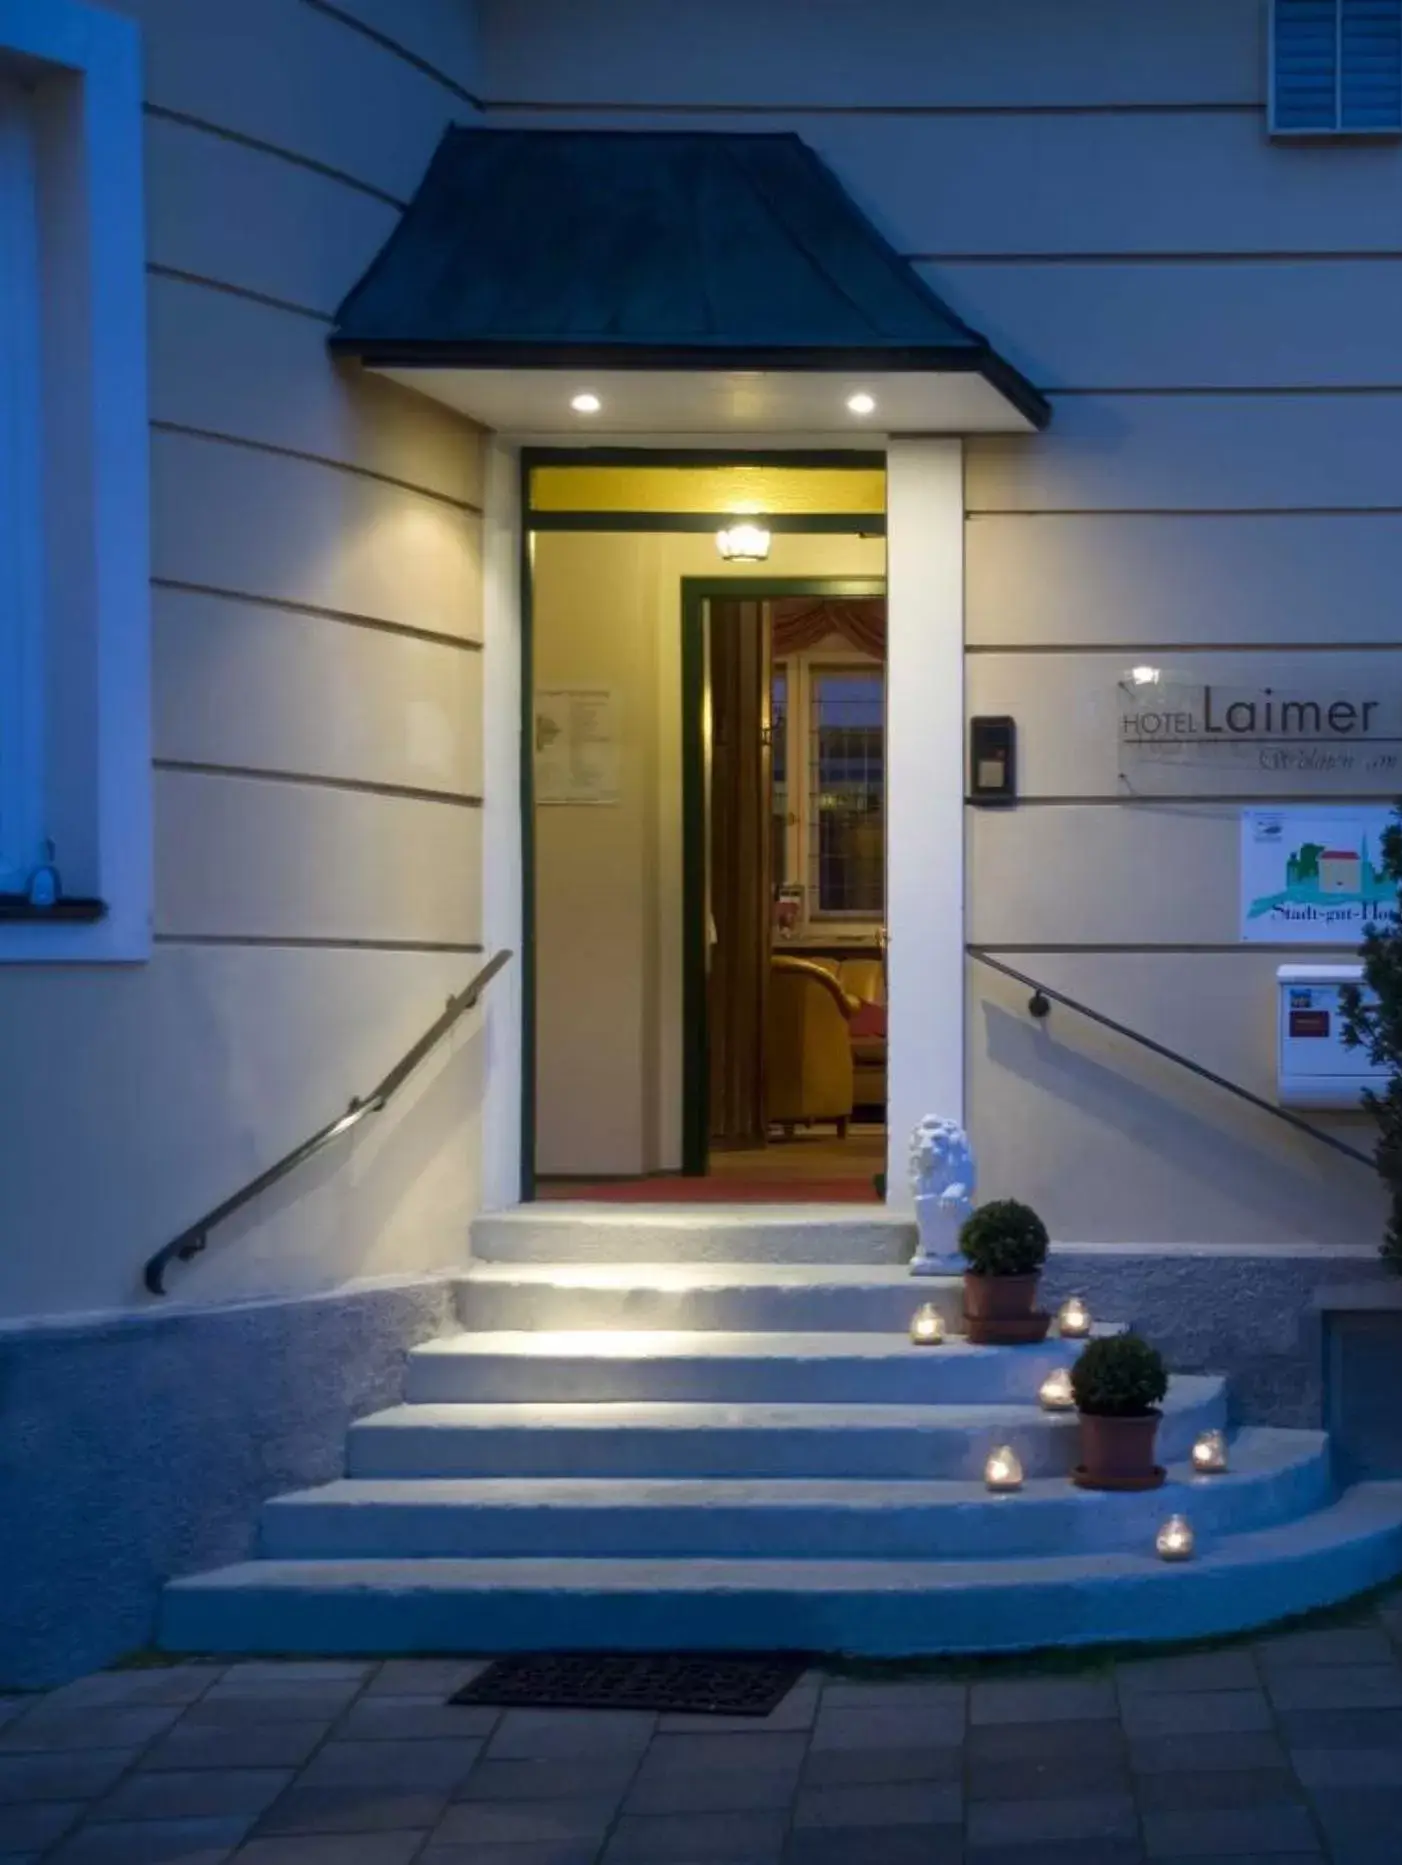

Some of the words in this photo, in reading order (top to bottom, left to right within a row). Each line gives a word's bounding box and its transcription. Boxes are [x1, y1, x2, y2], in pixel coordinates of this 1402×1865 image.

[1123, 712, 1197, 734] HOTEL
[1204, 685, 1380, 734] Laimer
[1271, 900, 1397, 925] Stadt-gut-Ho
